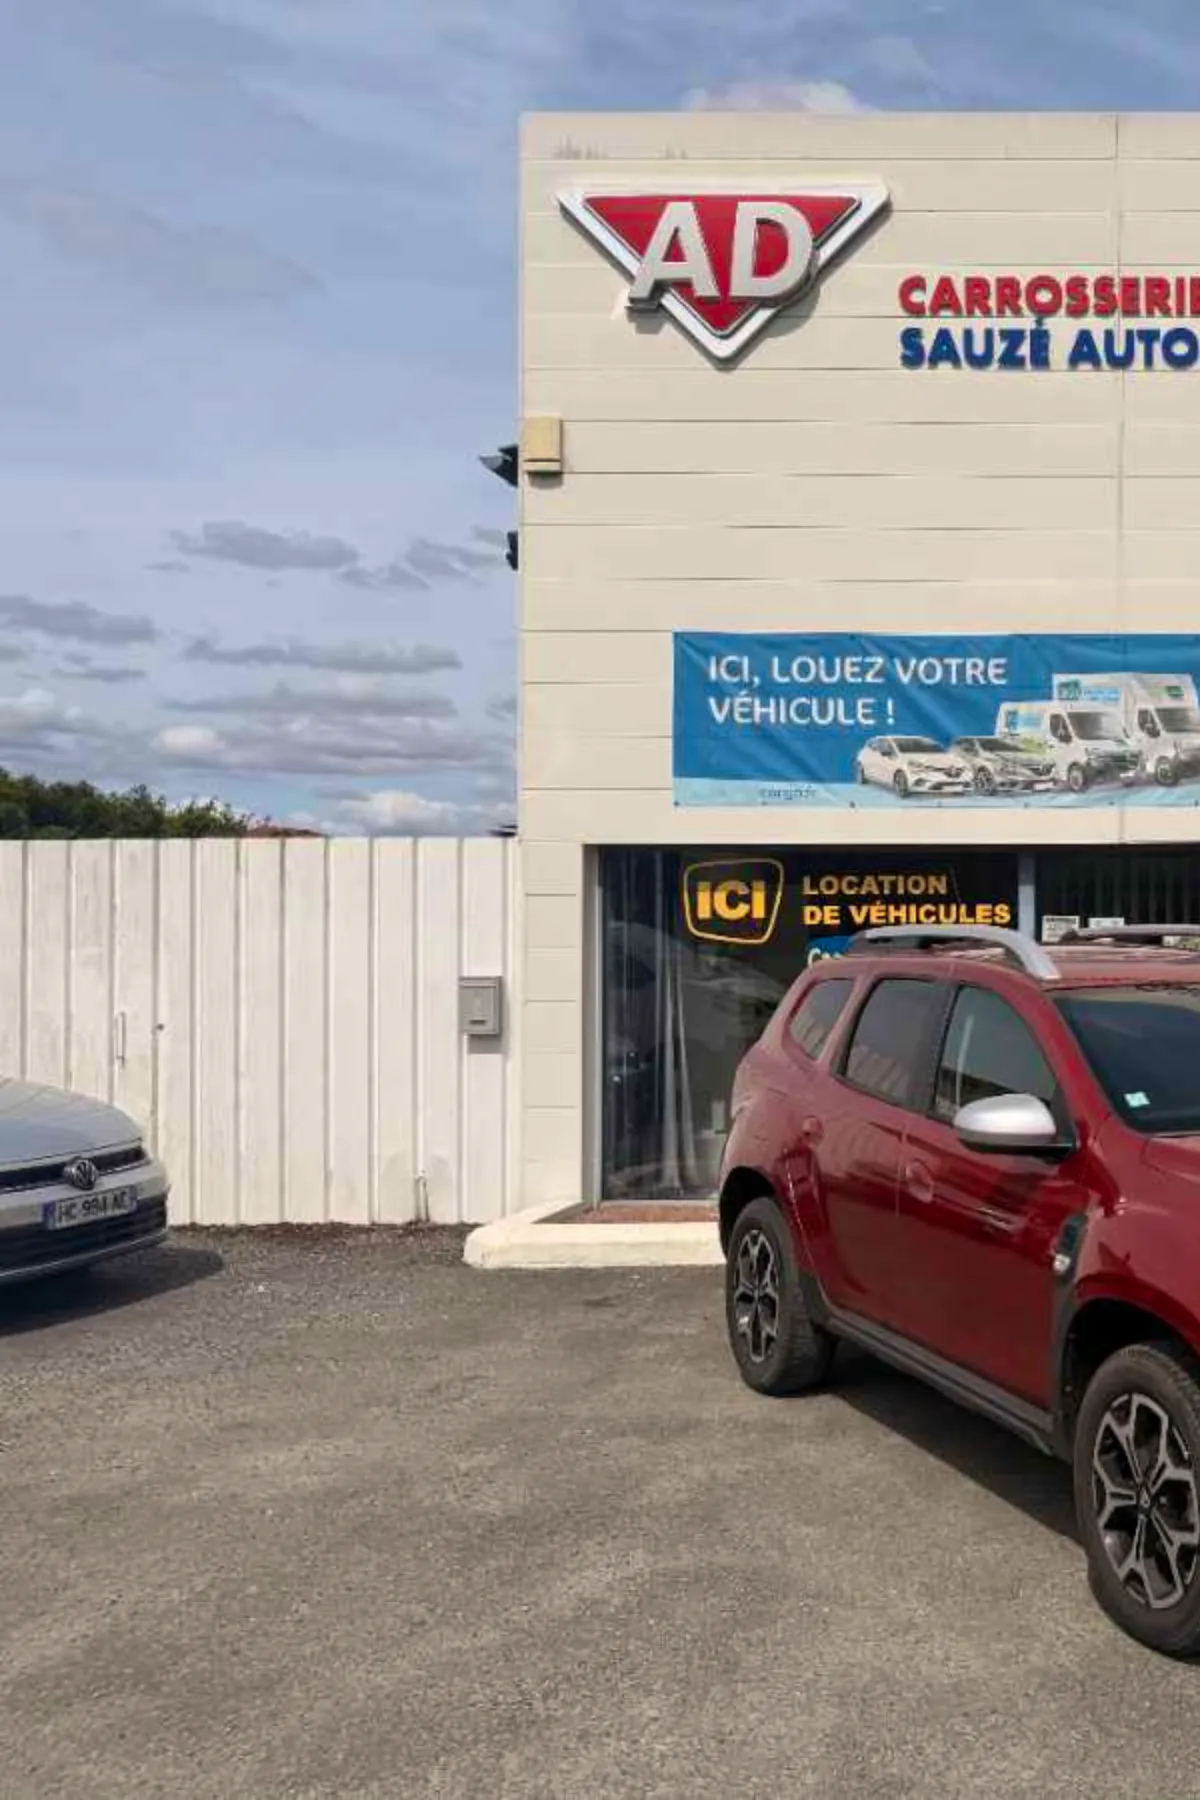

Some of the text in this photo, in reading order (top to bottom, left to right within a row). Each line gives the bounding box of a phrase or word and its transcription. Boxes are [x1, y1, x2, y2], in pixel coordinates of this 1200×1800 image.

[627, 200, 820, 301] AD
[899, 316, 1051, 370] SAUZÉ
[708, 655, 1008, 687] ICI, LOUEZ VOTRE
[709, 689, 876, 725] VÉHICULE
[696, 875, 948, 921] ICI LOCATION
[803, 900, 1012, 926] DE VÉHICULES
